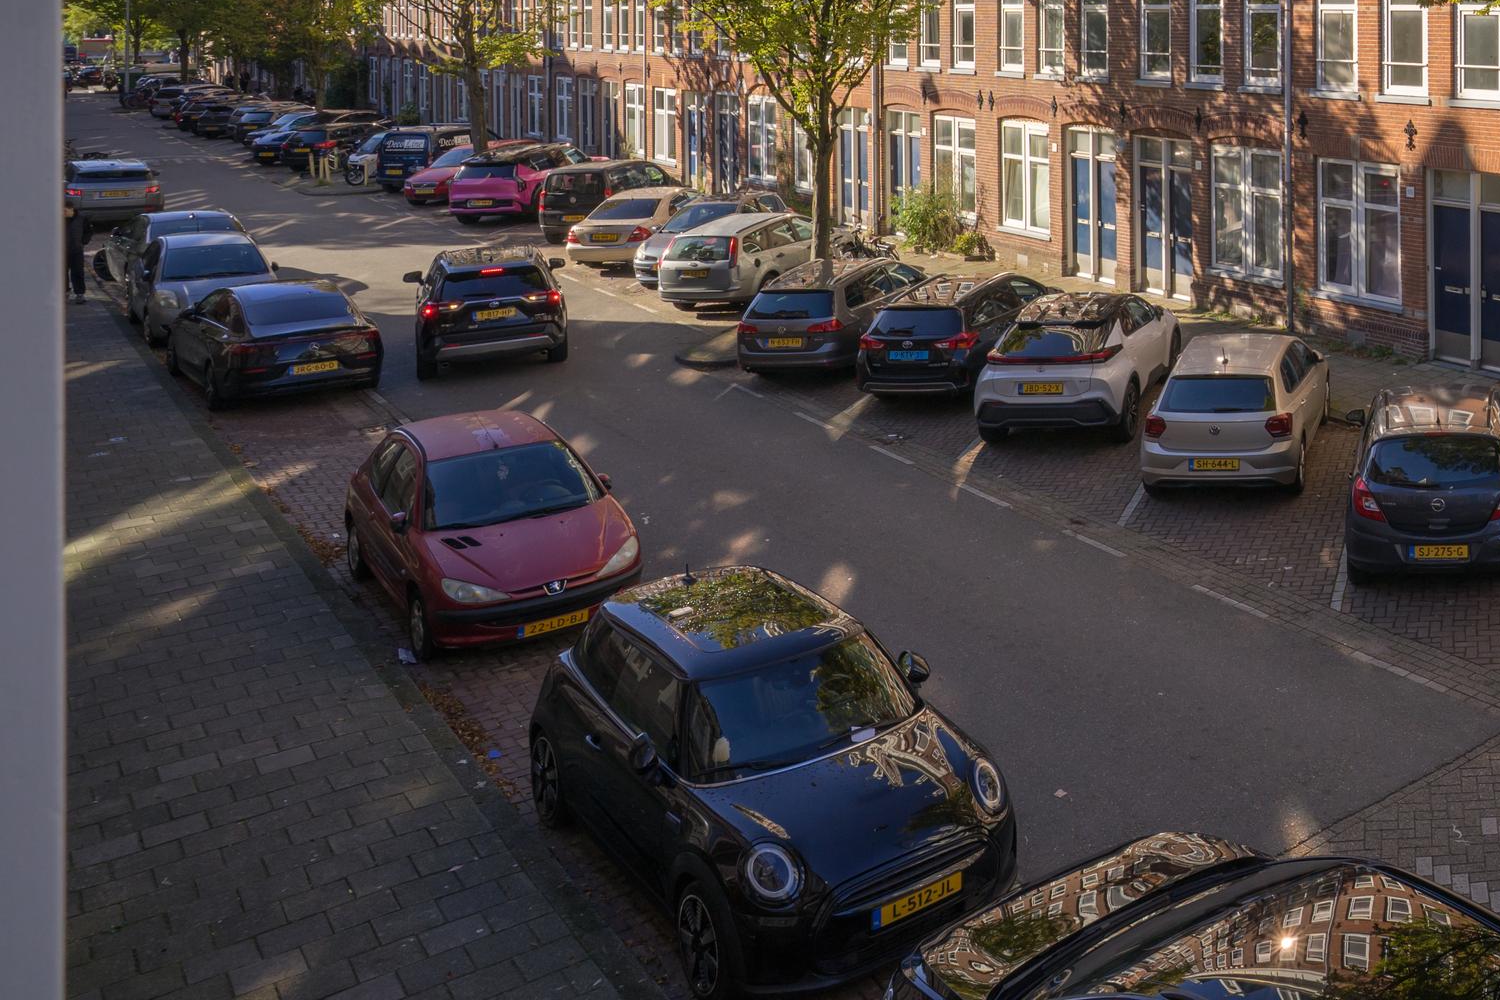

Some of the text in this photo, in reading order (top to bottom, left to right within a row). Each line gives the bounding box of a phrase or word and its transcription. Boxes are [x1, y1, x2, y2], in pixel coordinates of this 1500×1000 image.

[1196, 460, 1237, 468] SH-644-L
[1418, 546, 1464, 557] SJ-275-G
[530, 612, 585, 633] 22-LD-BJ
[892, 879, 954, 918] L-512-JL
